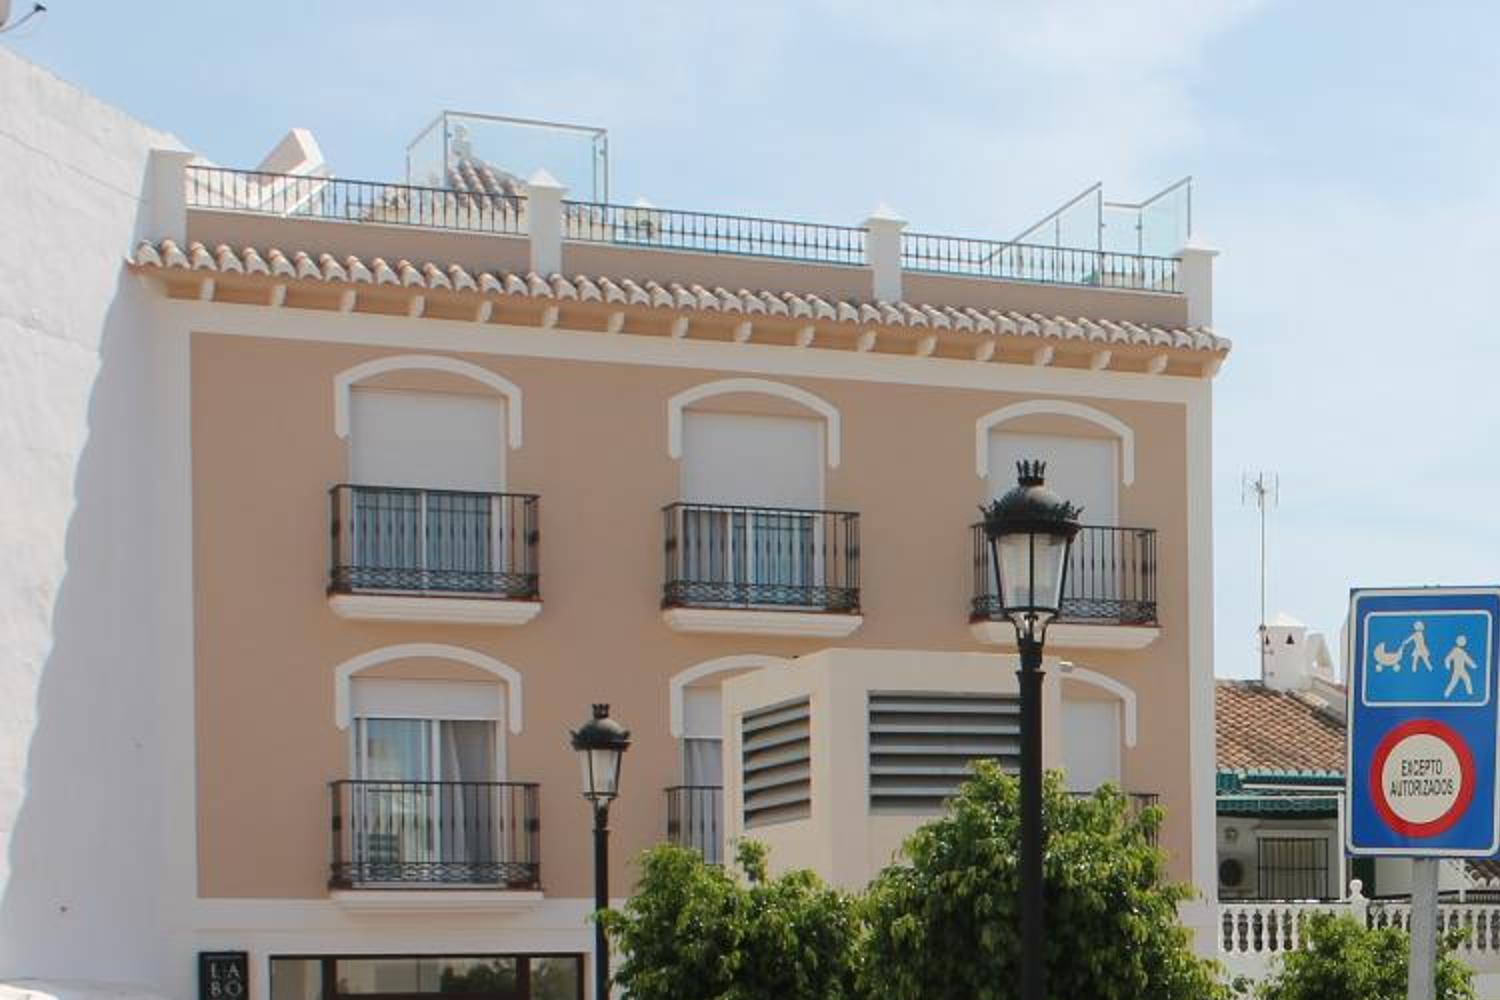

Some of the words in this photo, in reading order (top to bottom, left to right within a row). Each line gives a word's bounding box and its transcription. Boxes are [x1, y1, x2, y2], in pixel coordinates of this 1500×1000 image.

[1401, 759, 1443, 776] EXCEPTO
[1390, 779, 1453, 796] AUTORIZADOS
[210, 962, 241, 979] LA
